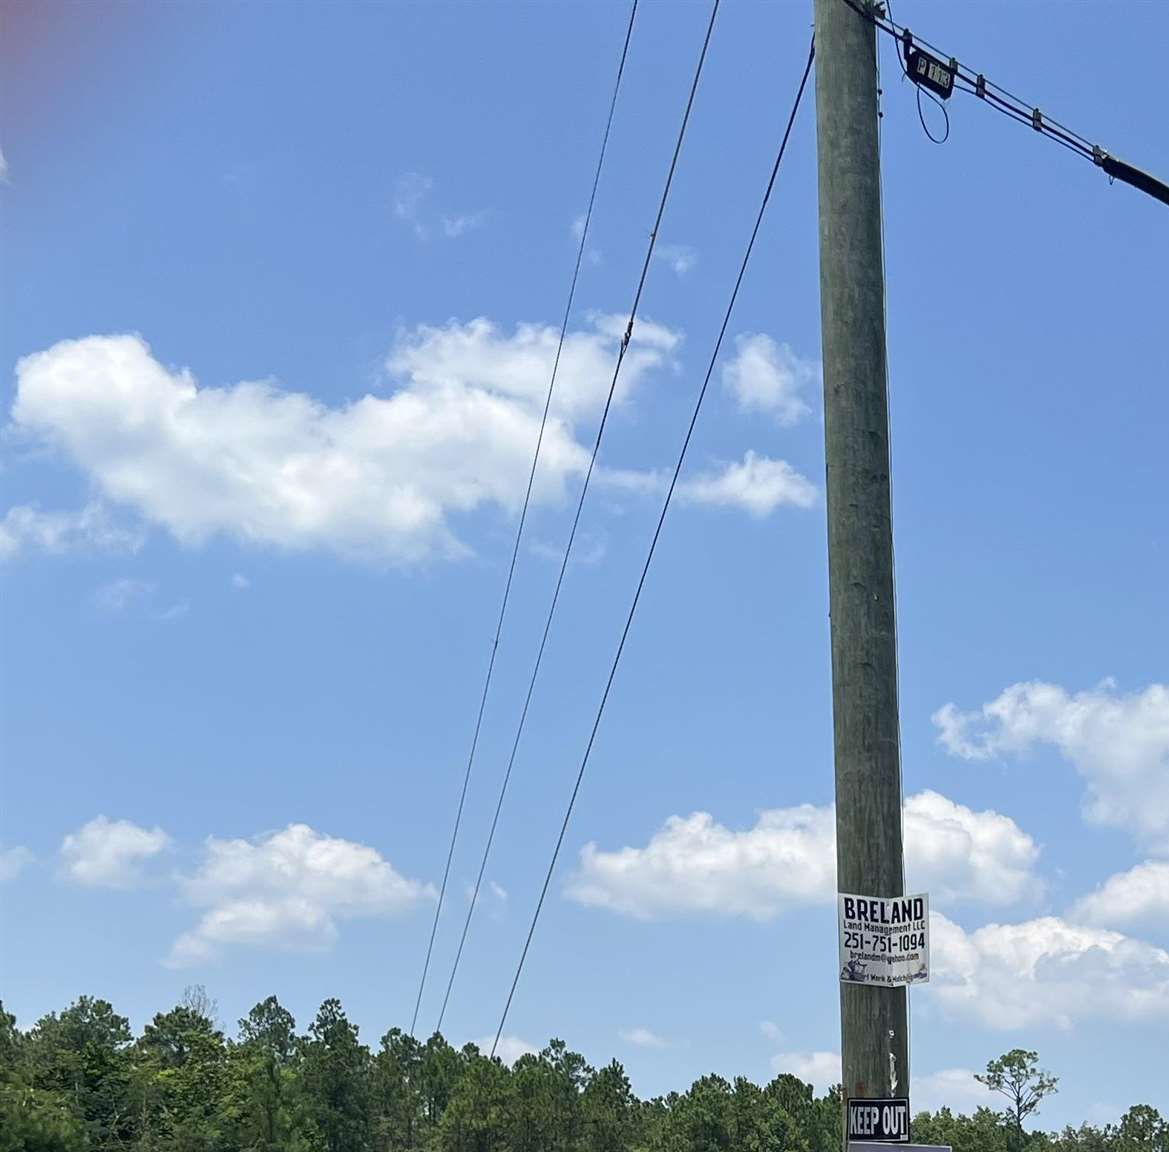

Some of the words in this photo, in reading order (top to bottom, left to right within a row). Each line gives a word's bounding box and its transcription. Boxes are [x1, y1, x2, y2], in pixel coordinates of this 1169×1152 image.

[844, 897, 924, 924] BRELAND
[844, 920, 862, 931] Land
[864, 922, 911, 935] Management
[912, 920, 926, 931] LLC
[844, 931, 926, 953] 251-751-1094
[850, 1105, 880, 1135] KEEP
[882, 1105, 906, 1135] OUT
